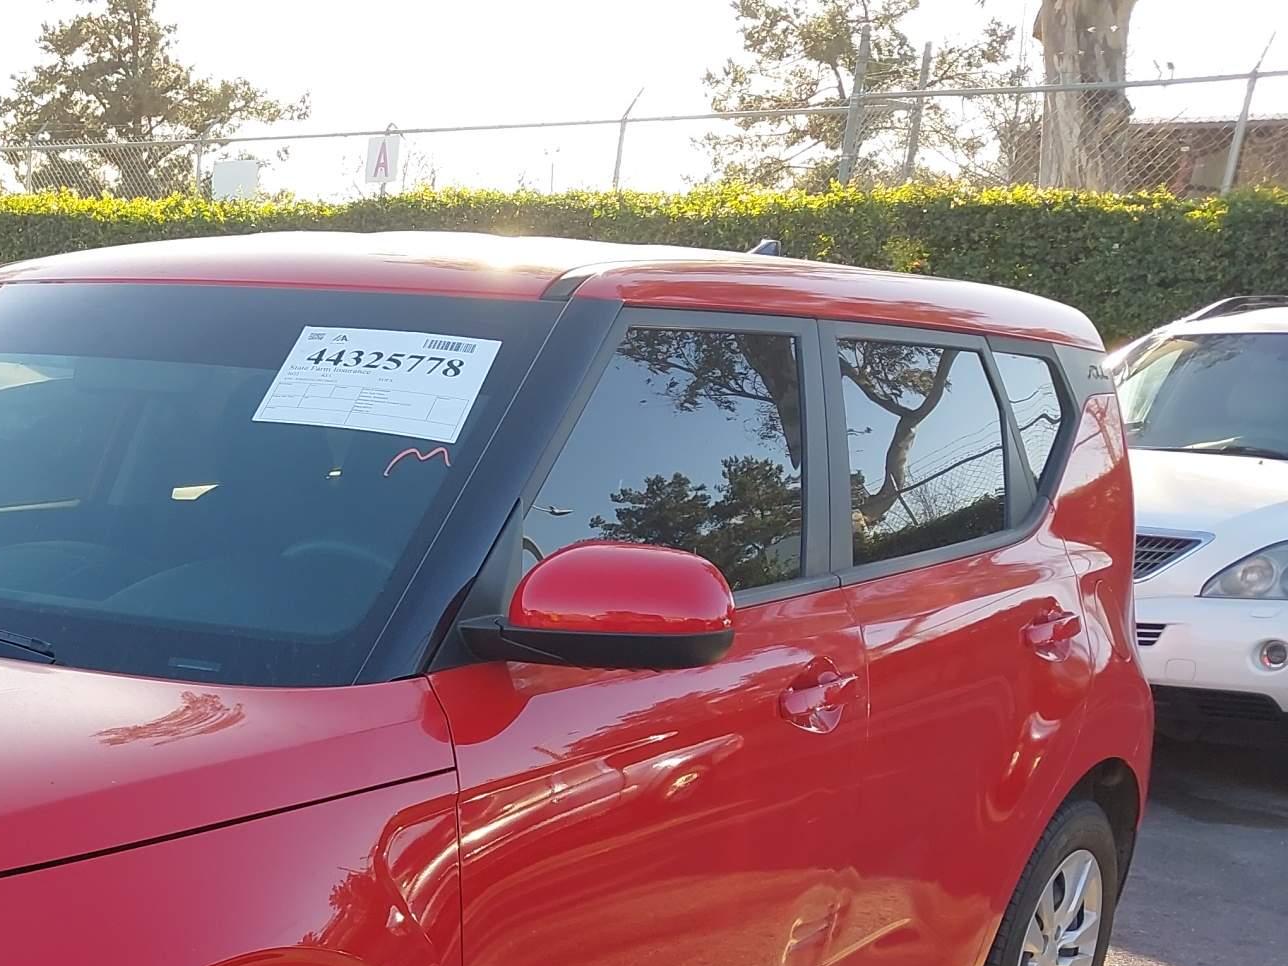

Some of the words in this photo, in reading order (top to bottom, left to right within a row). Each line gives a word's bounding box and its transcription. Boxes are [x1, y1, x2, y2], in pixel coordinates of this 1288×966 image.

[373, 140, 389, 178] A
[306, 347, 465, 377] 44325778
[310, 365, 331, 373] Farm
[333, 366, 372, 375] Insurance
